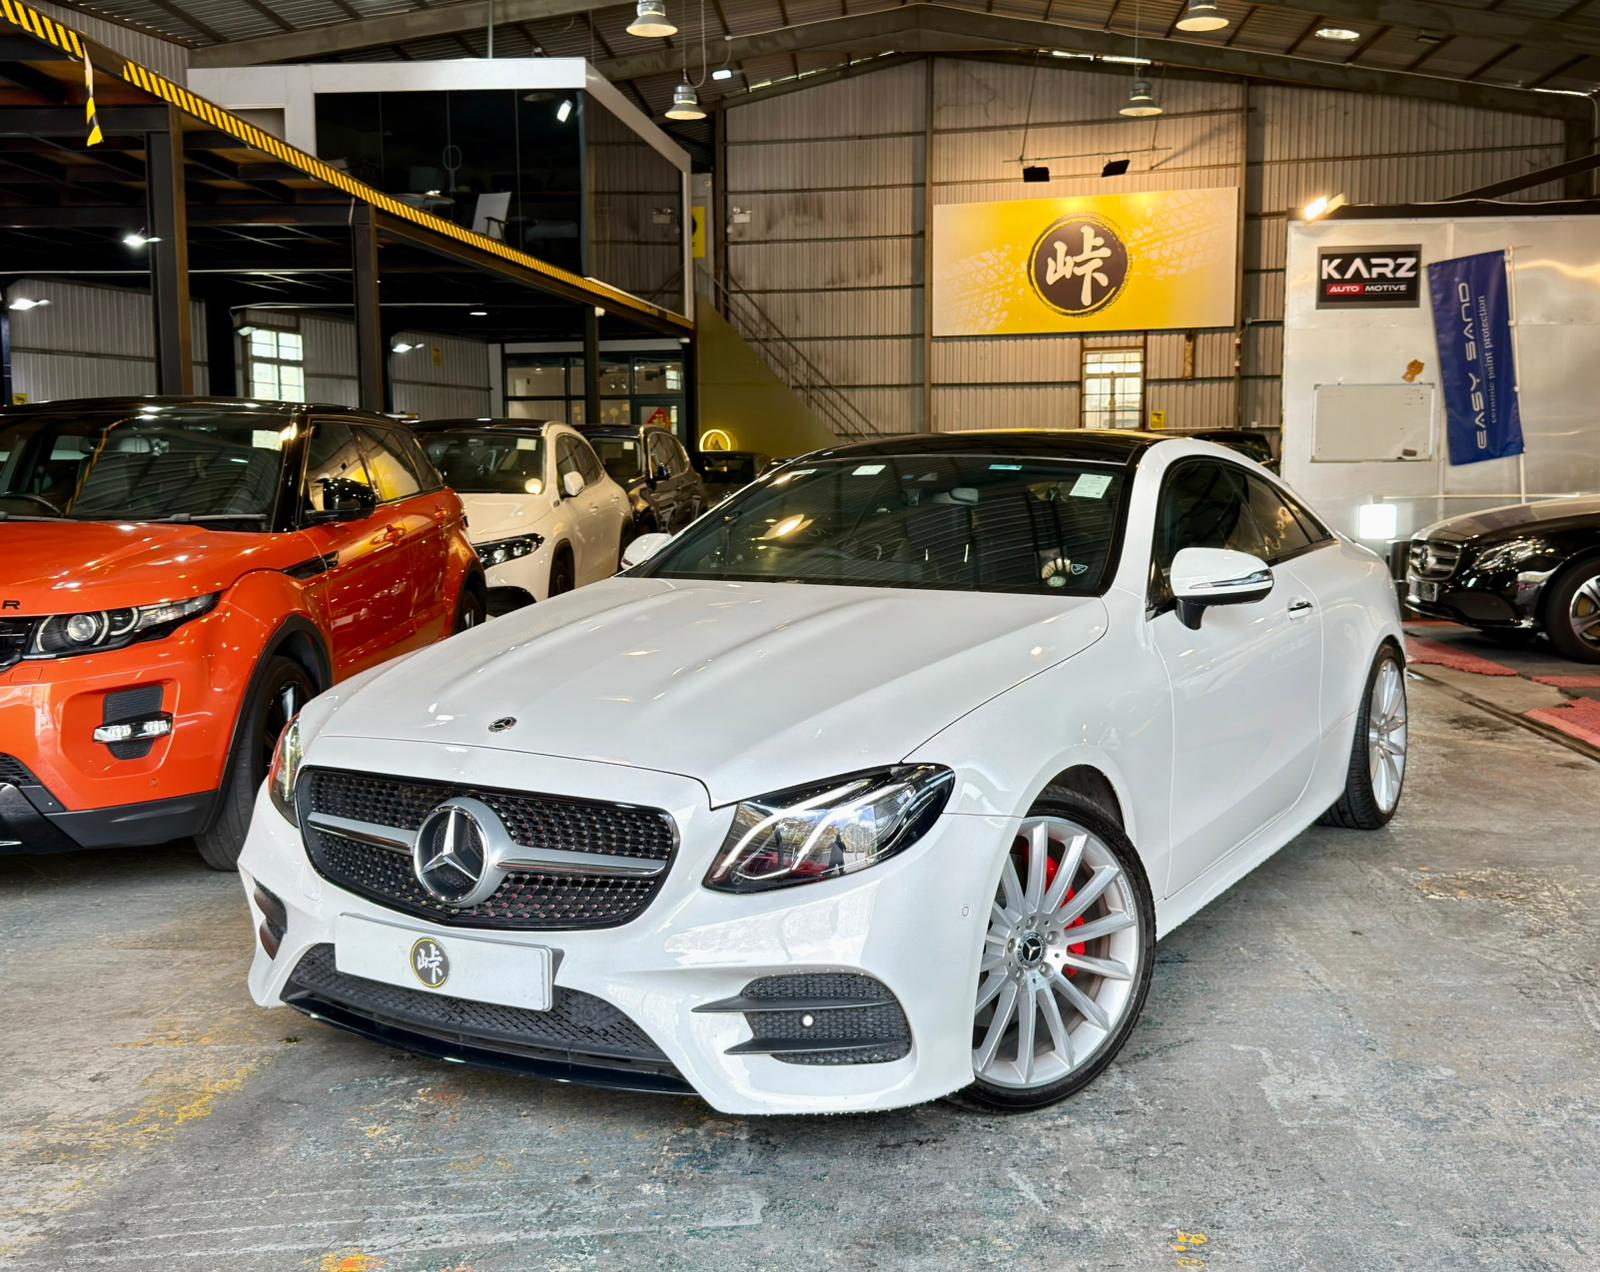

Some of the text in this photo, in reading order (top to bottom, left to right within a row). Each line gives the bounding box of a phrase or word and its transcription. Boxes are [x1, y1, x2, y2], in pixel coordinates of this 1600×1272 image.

[1046, 225, 1112, 306] 峠
[1321, 257, 1417, 280] KARZ
[1329, 284, 1407, 293] AUTO MOTIVE
[1458, 283, 1487, 449] EASY SAND
[1478, 295, 1497, 424] ceramic paint protection
[417, 943, 443, 984] 峠
